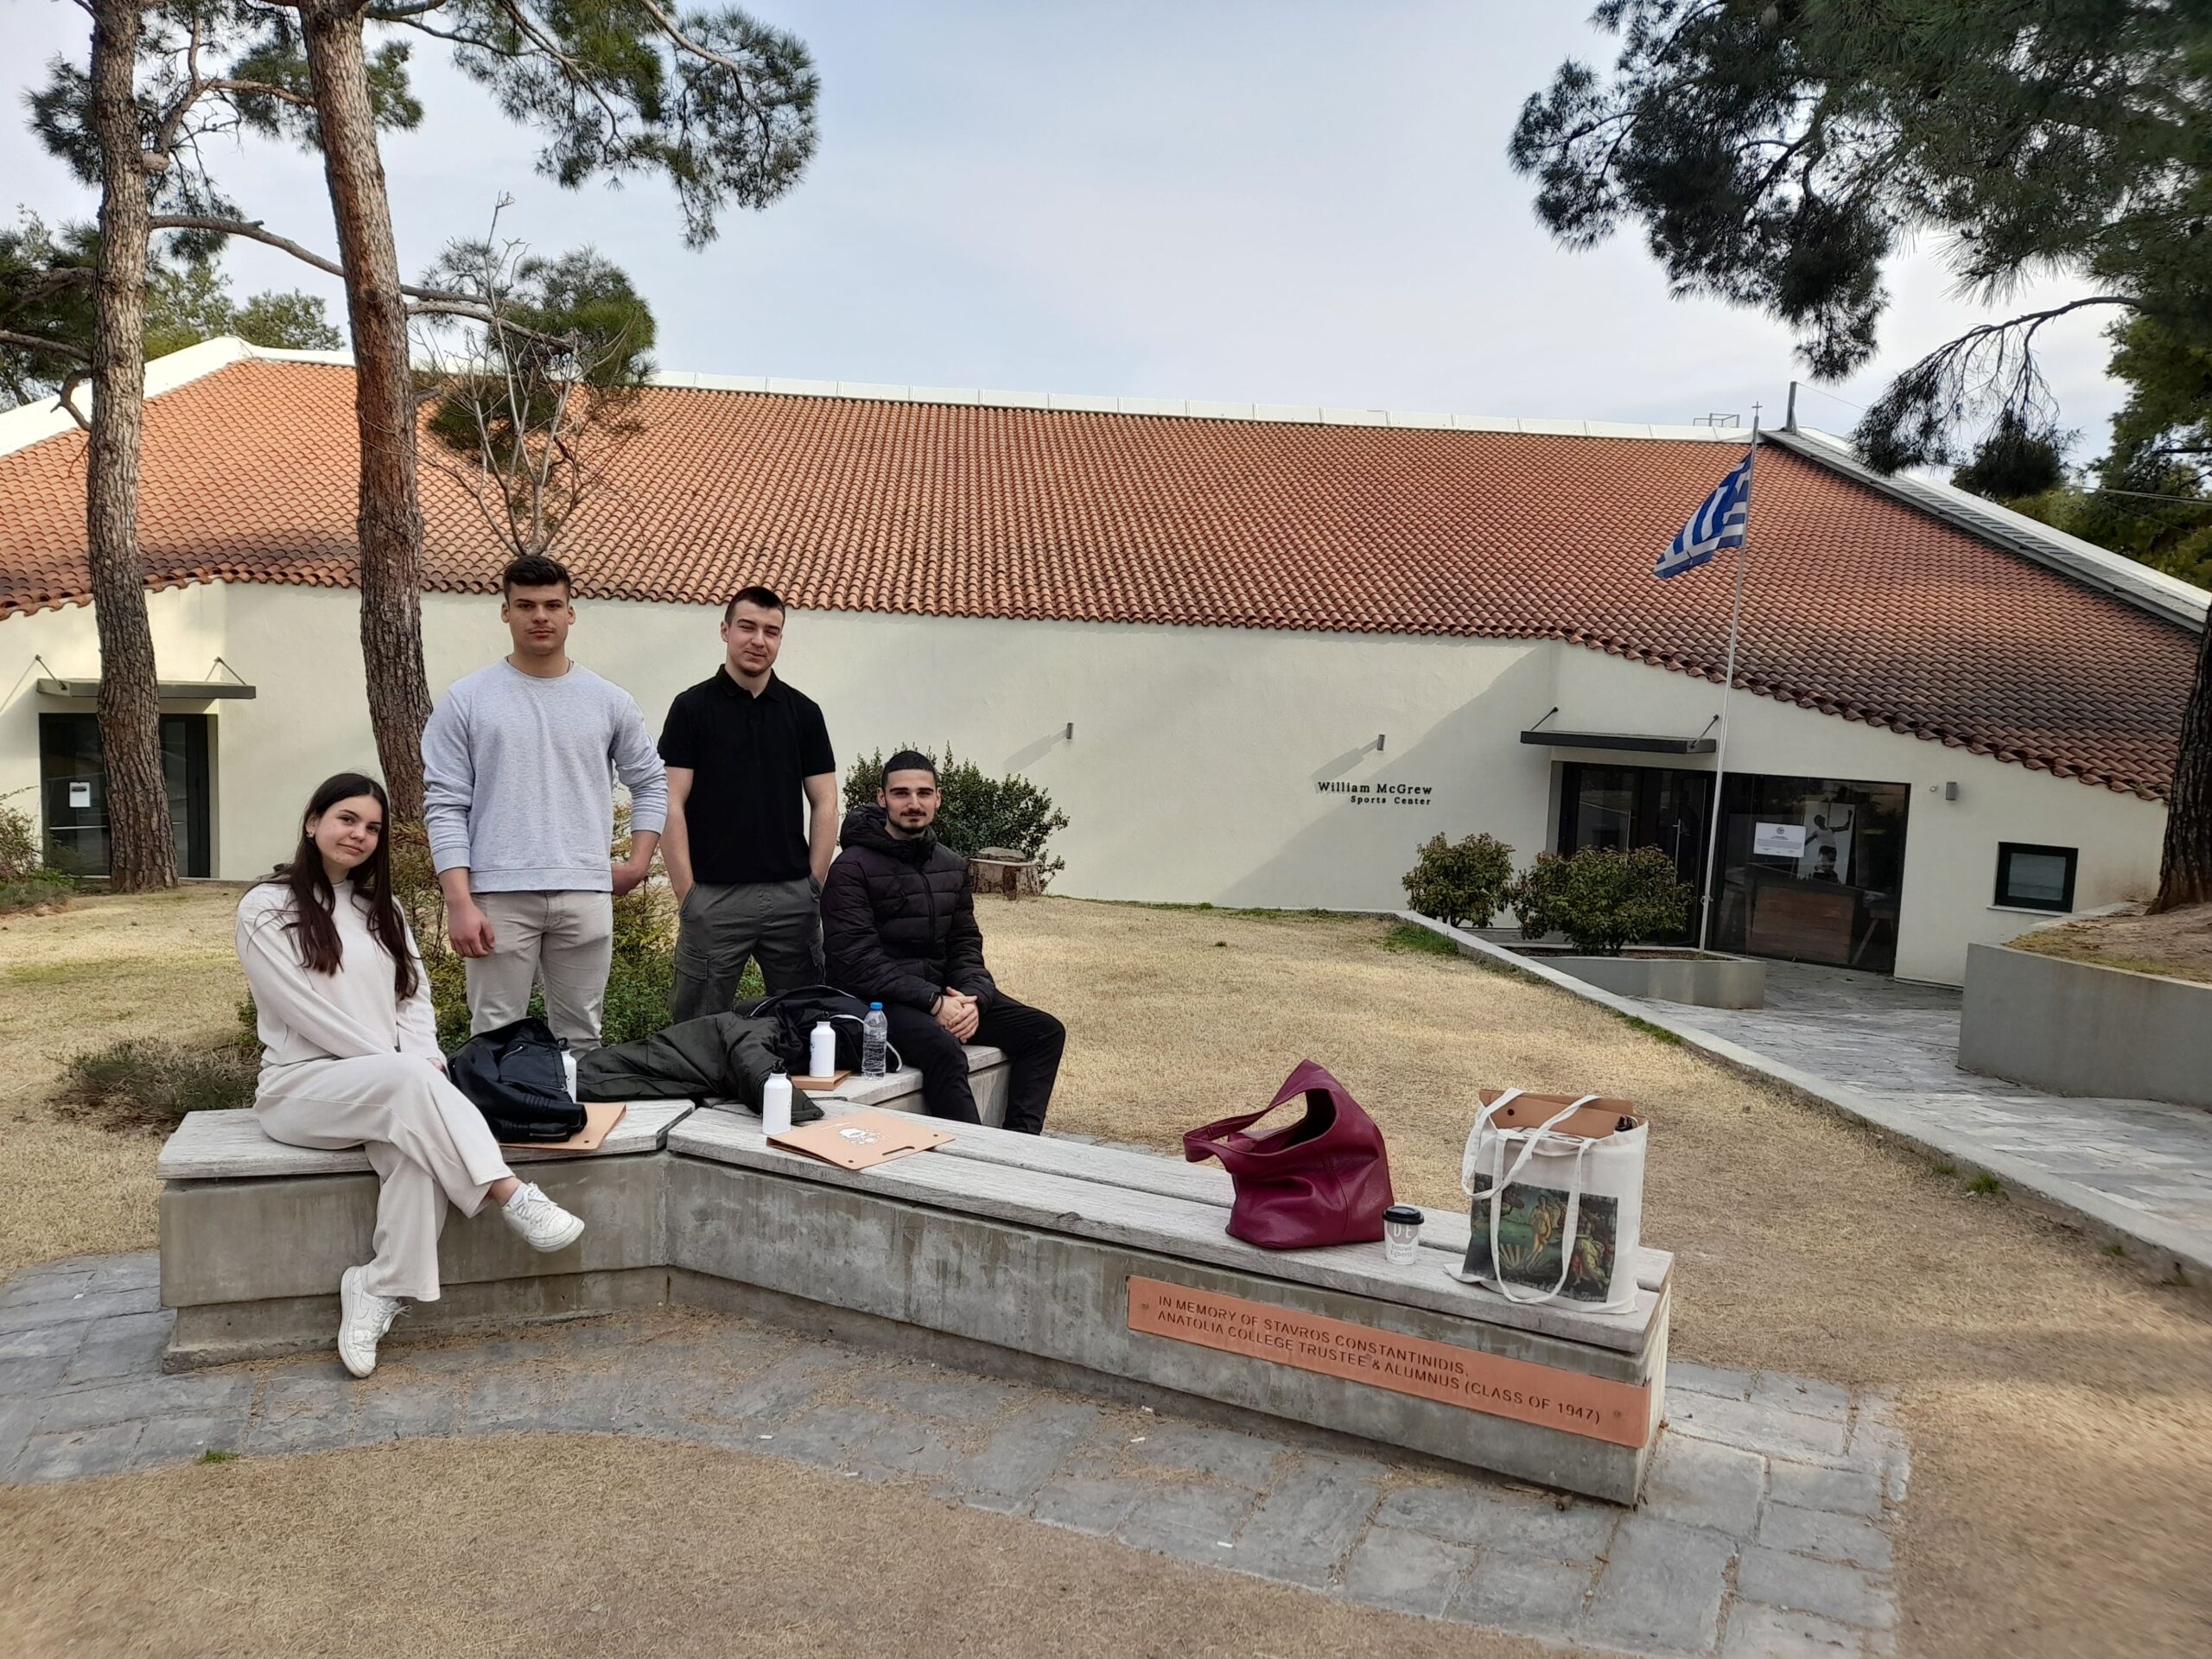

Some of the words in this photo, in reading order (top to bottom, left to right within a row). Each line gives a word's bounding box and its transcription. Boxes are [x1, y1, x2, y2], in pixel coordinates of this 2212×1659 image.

[1318, 781, 1370, 793] William
[1376, 783, 1433, 795] McGrew
[1351, 795, 1387, 804] Sports
[1394, 797, 1431, 805] Center
[1159, 1295, 1172, 1307] IN
[1176, 1299, 1236, 1321] MEMORY
[1241, 1313, 1259, 1327] OF
[1263, 1319, 1330, 1344] STAVROS
[1335, 1335, 1469, 1377] CONSTANTINIDIS,
[1158, 1311, 1224, 1335] ANATOLIA
[1228, 1326, 1294, 1351] COLLEGE
[1299, 1342, 1367, 1368] TRUSTEE
[1371, 1359, 1381, 1371] &
[1384, 1363, 1459, 1389] ALUMNUS
[1465, 1381, 1523, 1404] (CLASS
[1529, 1395, 1551, 1409] OF
[1558, 1402, 1600, 1425] 1947)
